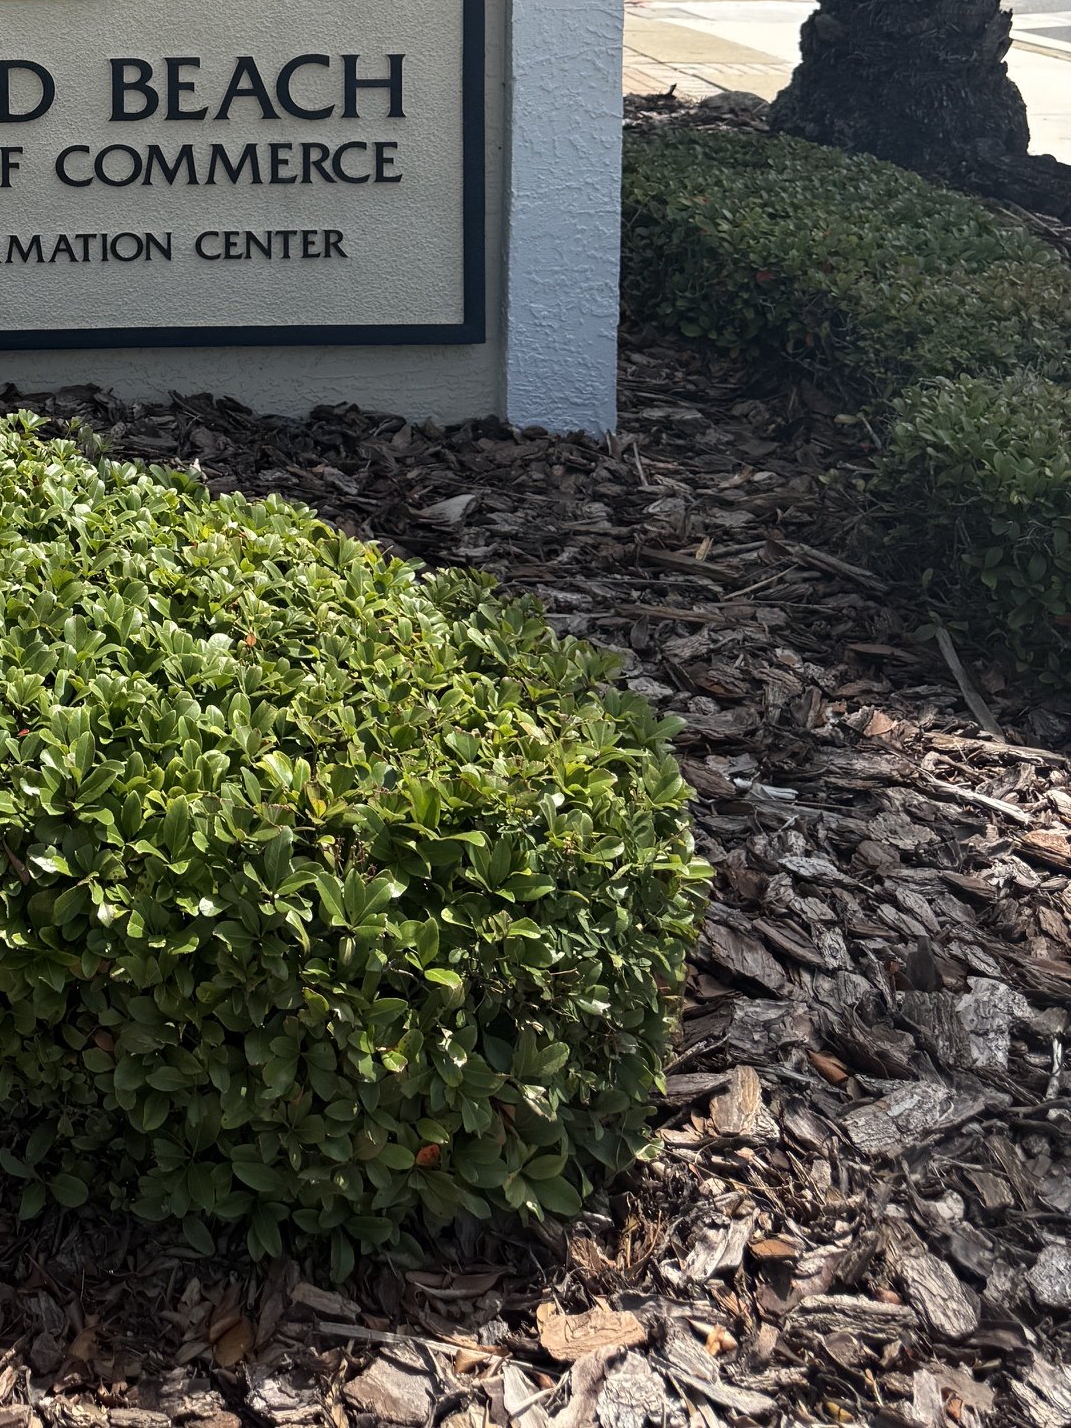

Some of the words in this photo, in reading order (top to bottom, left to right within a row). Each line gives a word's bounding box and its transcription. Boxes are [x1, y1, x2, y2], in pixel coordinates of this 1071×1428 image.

[109, 53, 407, 123] BEACH
[55, 141, 404, 188] COMMERCE
[195, 229, 349, 261] CENTER
